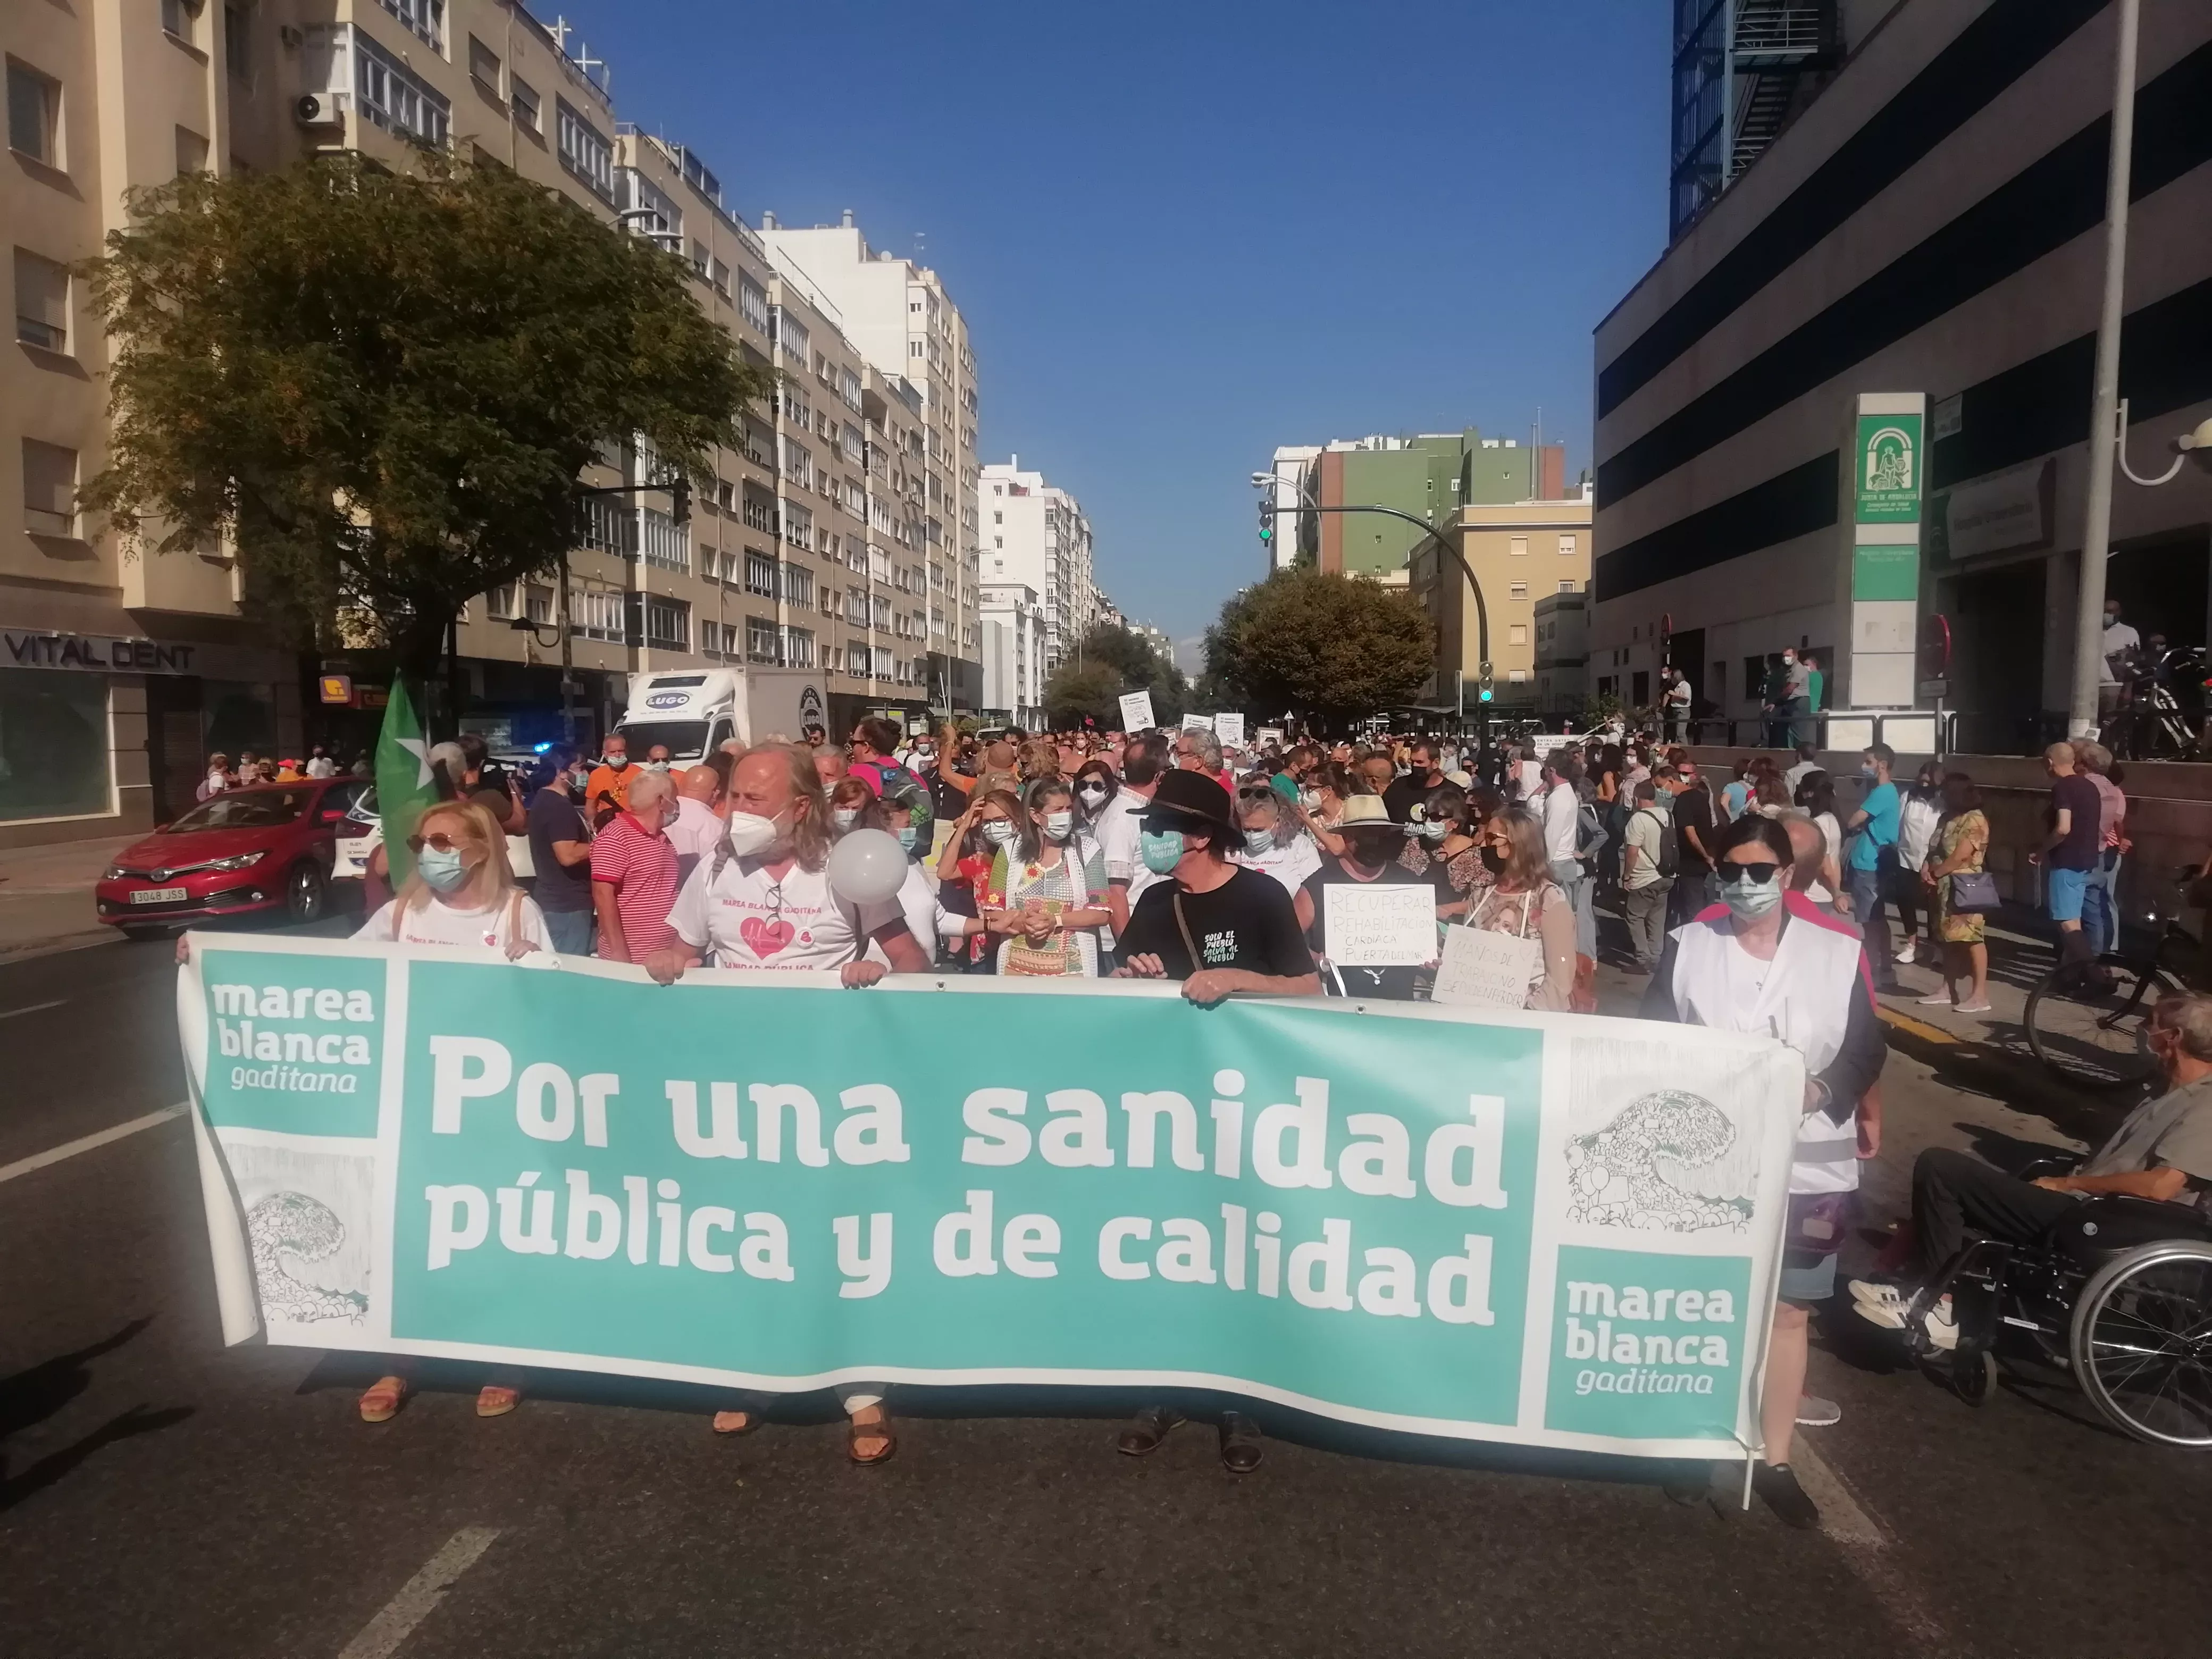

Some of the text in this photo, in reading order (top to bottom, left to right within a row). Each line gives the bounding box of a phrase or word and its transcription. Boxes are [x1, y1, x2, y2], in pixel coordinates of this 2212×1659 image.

[4, 633, 195, 669] VITAL DENT
[647, 697, 689, 705] LUGO
[803, 715, 819, 725] LUGO
[137, 890, 184, 902] 3048 JSS
[722, 899, 745, 908] MAREA
[1331, 890, 1434, 914] RECUPERAR
[1204, 930, 1235, 942] SOLO EL
[1206, 938, 1234, 949] PUEBLO
[1203, 944, 1238, 957] SALVA AL
[1207, 952, 1235, 963] PUEBLO
[1464, 943, 1498, 962] AÑOS
[1500, 953, 1513, 966] DE
[1452, 961, 1515, 988] TRABAJO NO
[211, 984, 375, 1022] marea
[216, 1018, 371, 1065] blanca
[231, 1064, 357, 1093] gaditana
[430, 1035, 1508, 1210] Por una sanidad
[425, 1168, 1495, 1327] pública y de calidad
[1566, 1280, 1735, 1323] marea
[1565, 1317, 1730, 1368] blanca
[1575, 1367, 1714, 1396] gaditana
